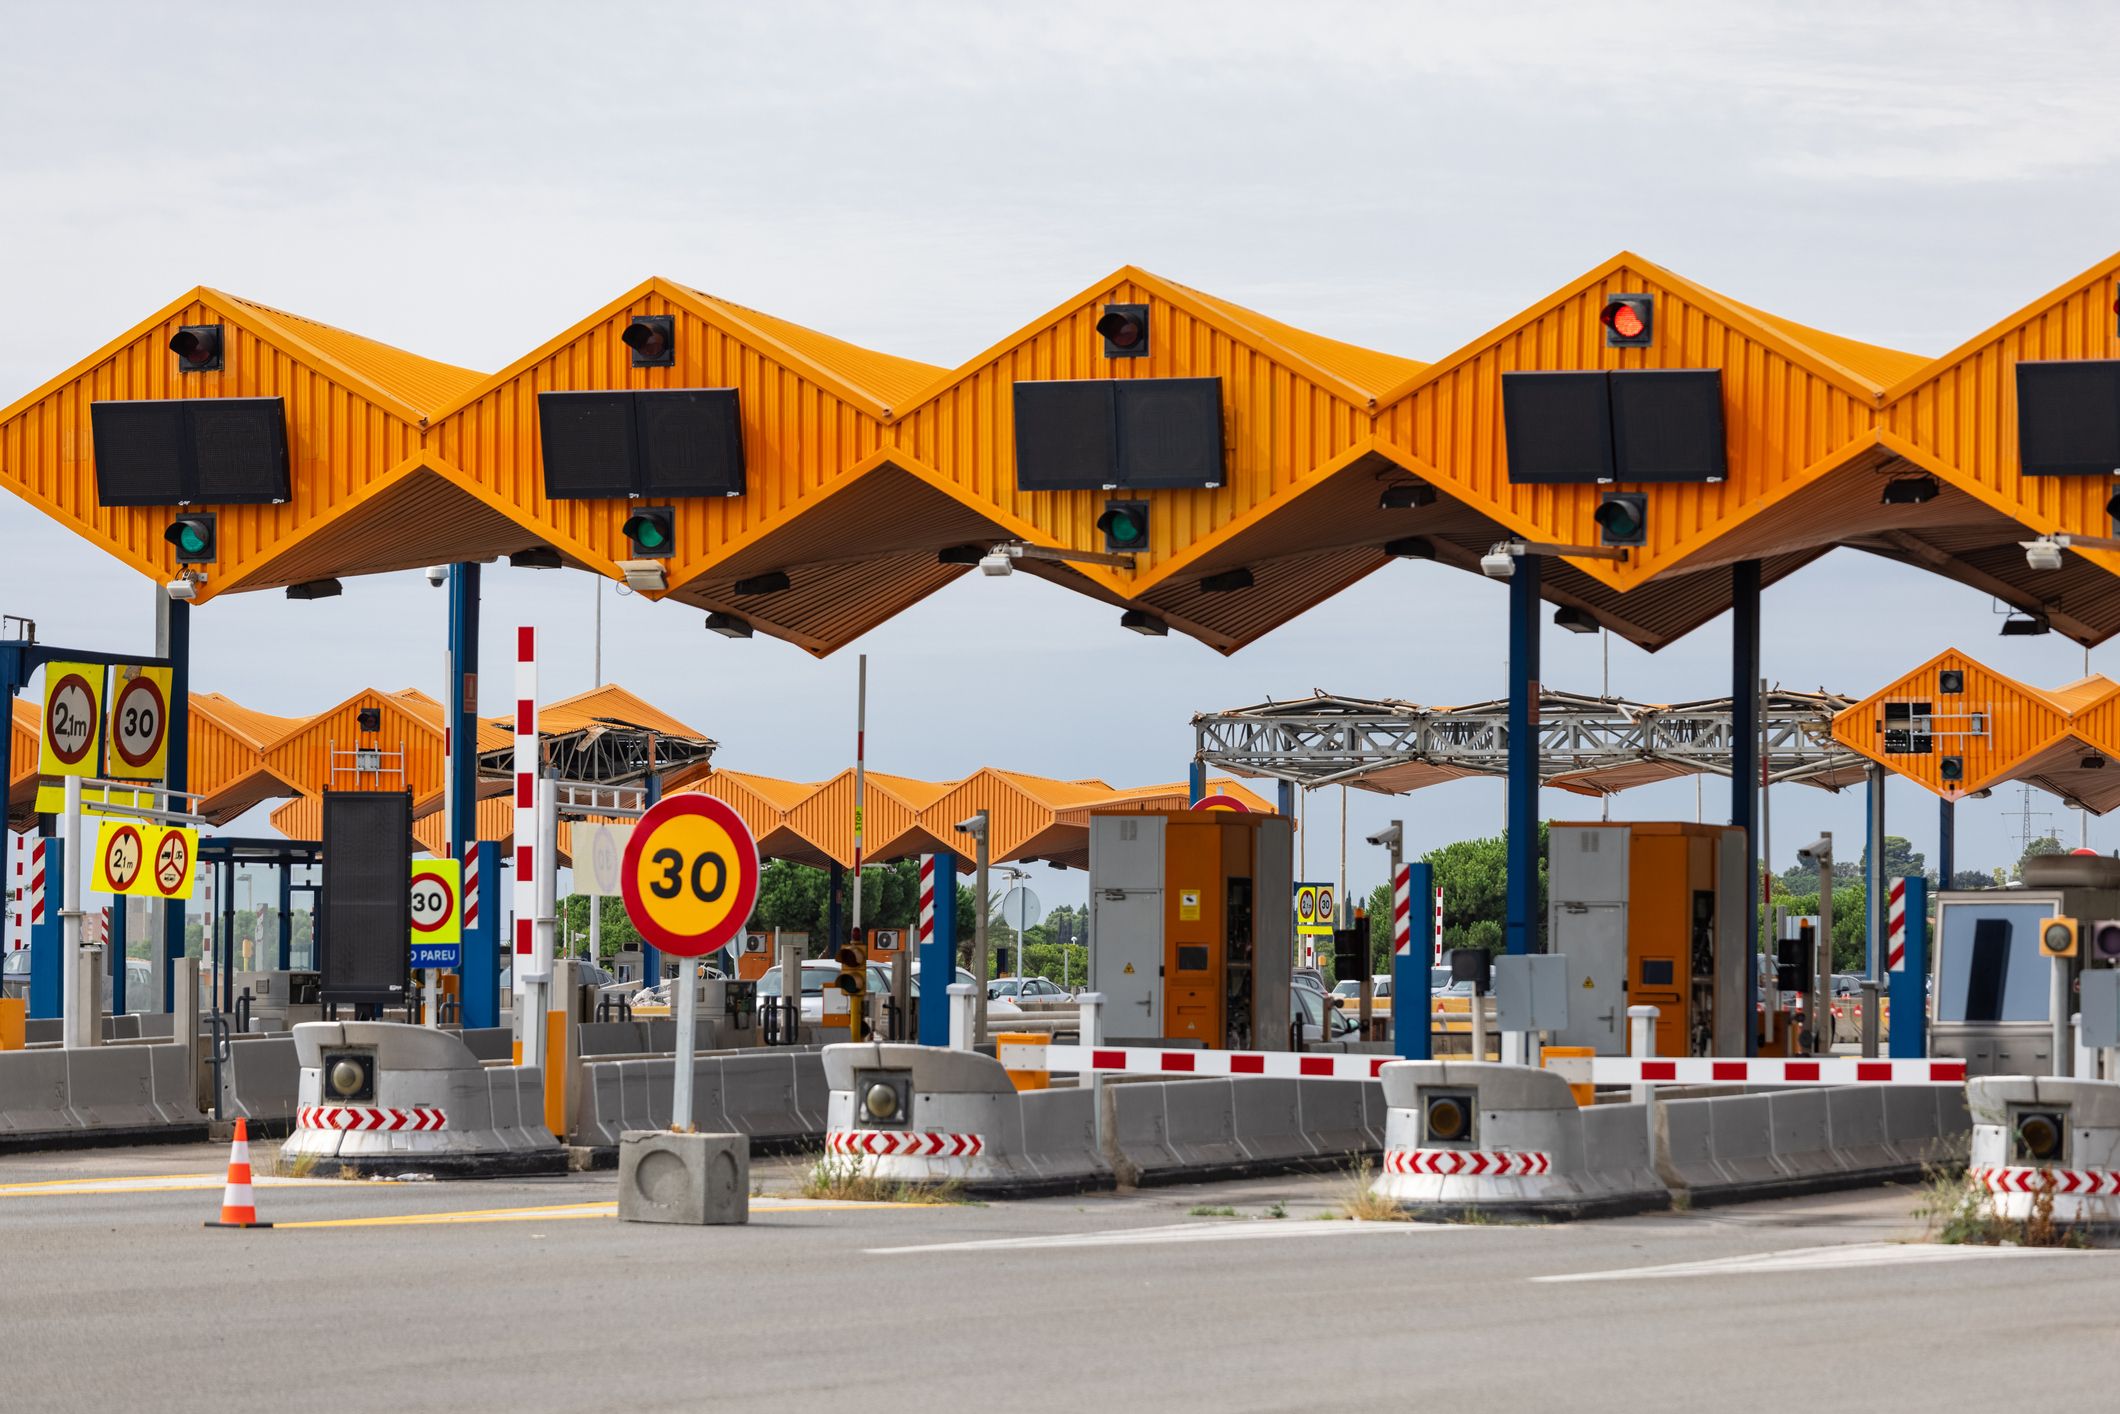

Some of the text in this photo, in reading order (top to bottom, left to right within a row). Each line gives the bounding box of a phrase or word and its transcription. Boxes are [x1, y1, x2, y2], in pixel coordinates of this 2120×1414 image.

[55, 702, 87, 737] 2,1m
[124, 707, 154, 738] 30
[650, 848, 727, 903] 30
[412, 893, 442, 912] 30
[1321, 899, 1330, 909] 30
[420, 950, 456, 961] PAREU
